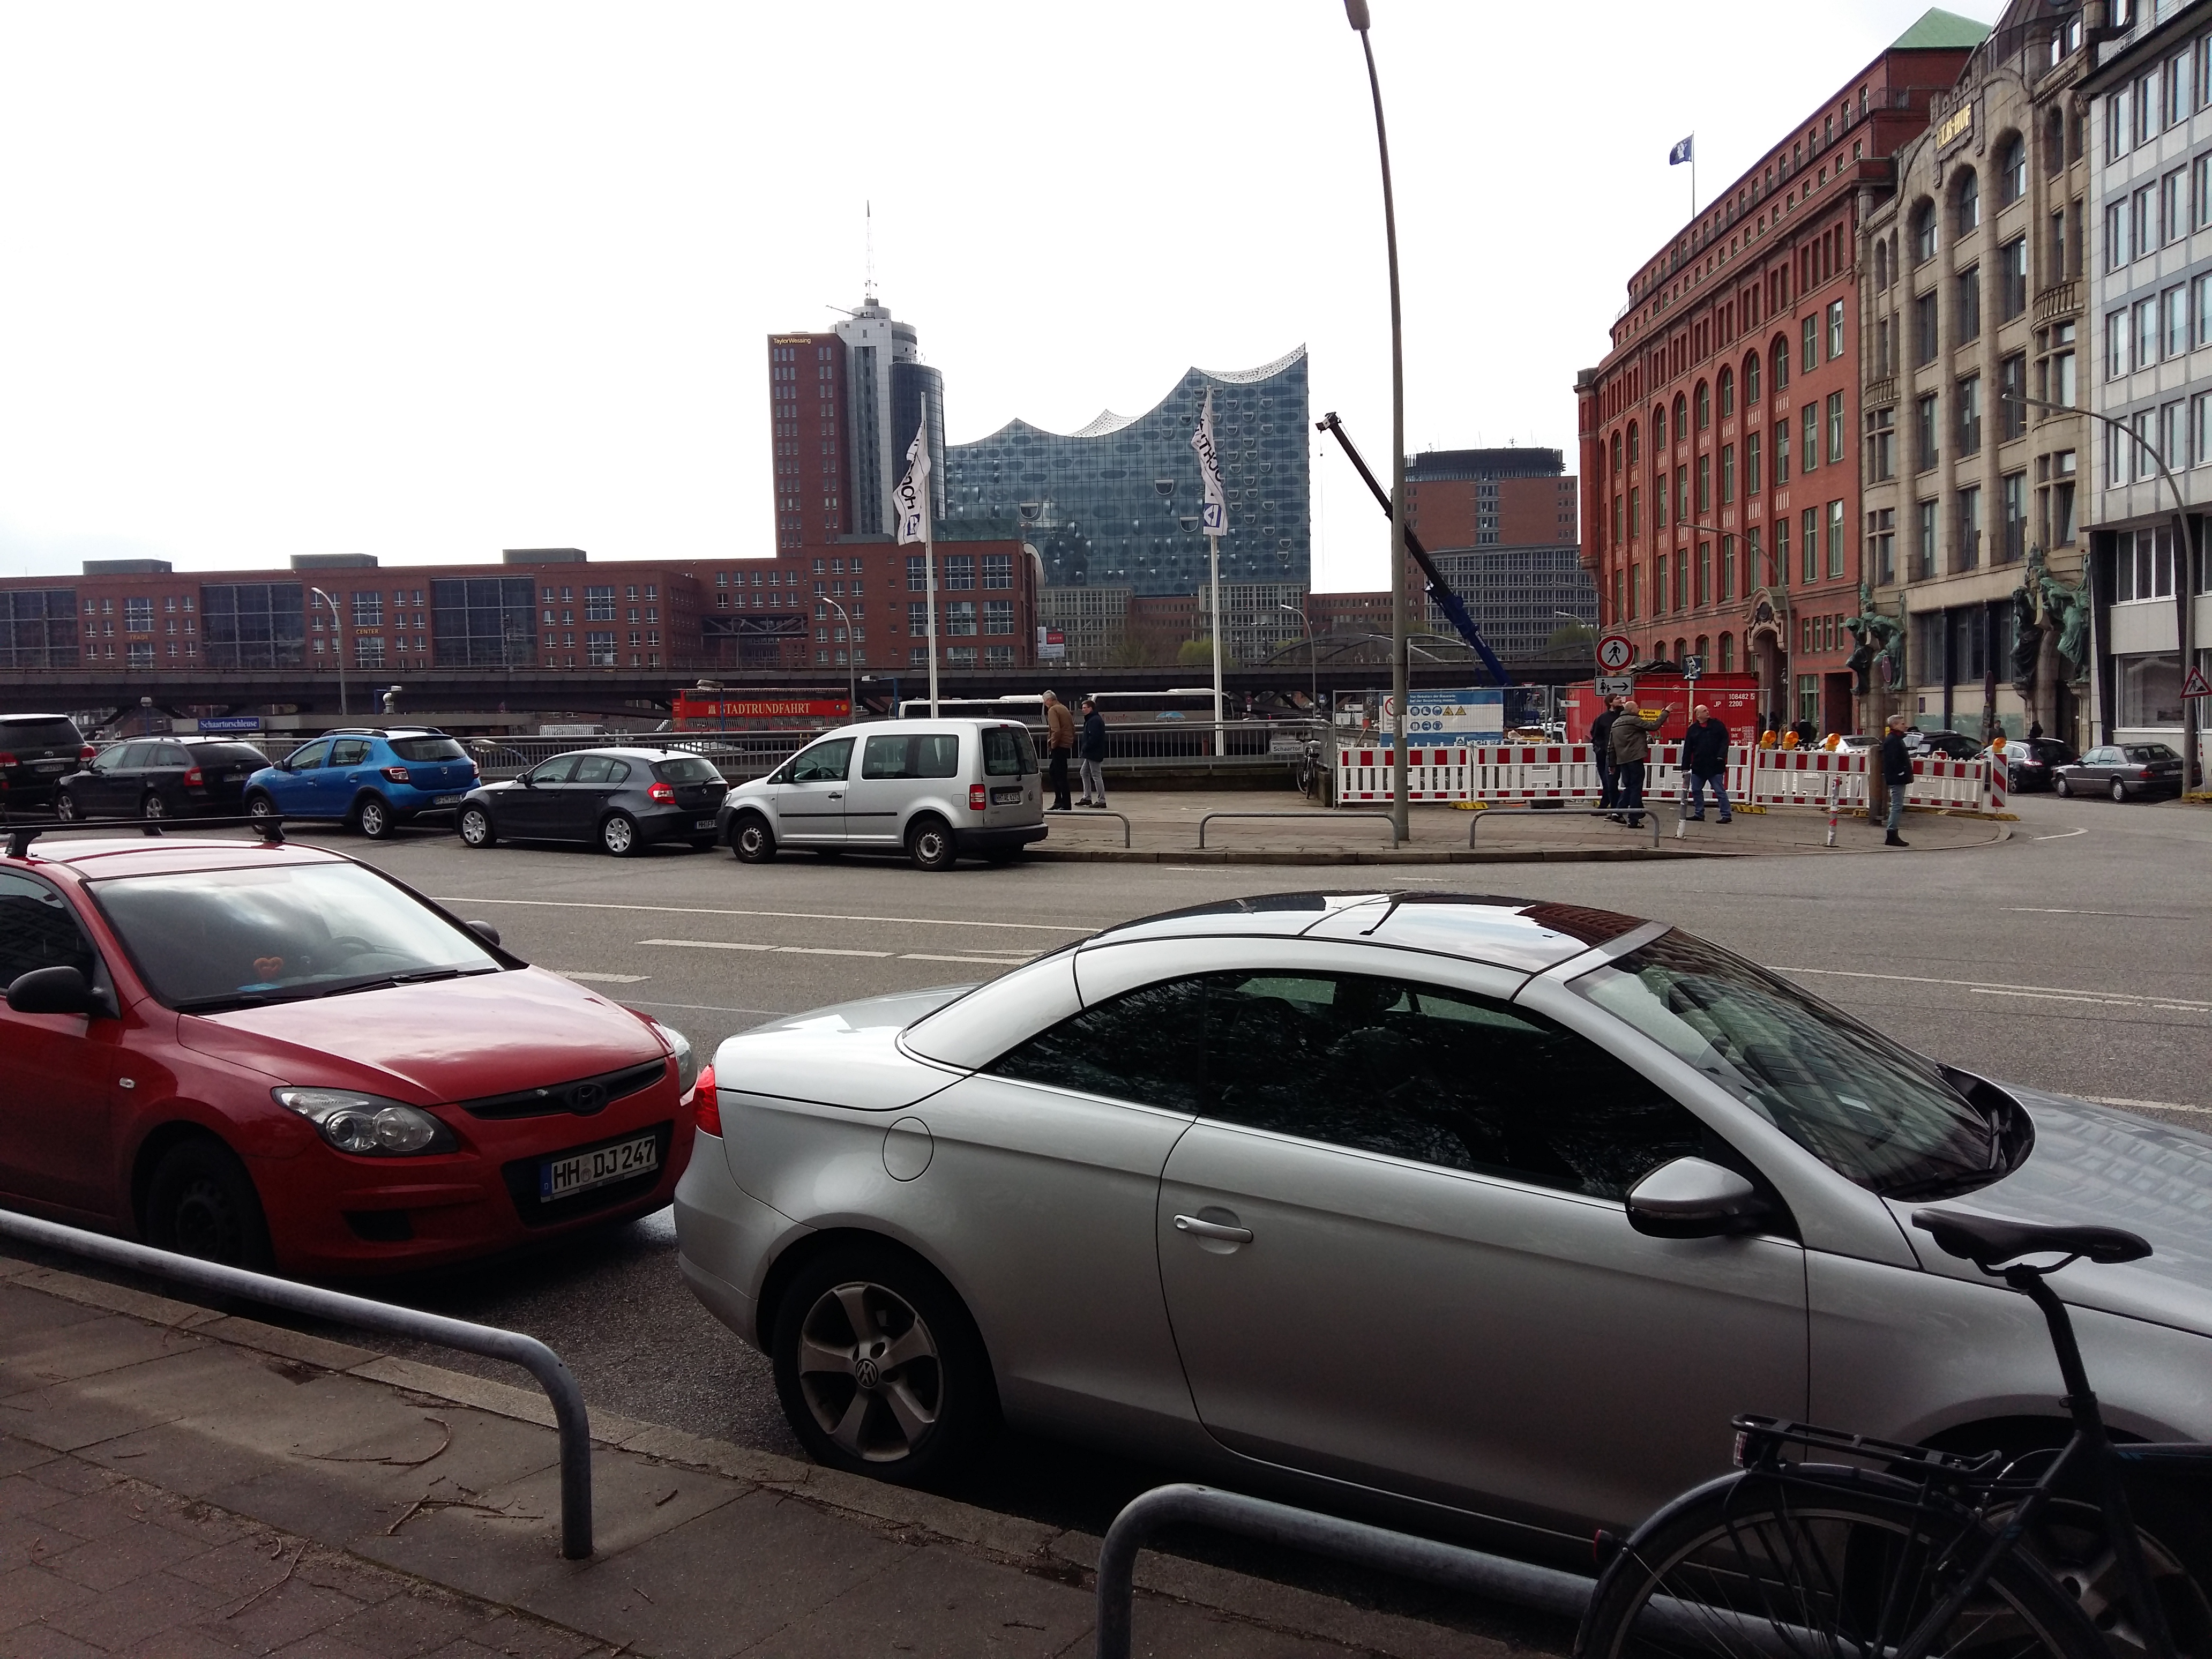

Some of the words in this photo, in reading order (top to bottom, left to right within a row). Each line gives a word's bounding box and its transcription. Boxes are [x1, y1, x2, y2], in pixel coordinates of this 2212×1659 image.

[200, 719, 257, 728] Schaartorschleuse
[554, 1159, 580, 1190] HH
[593, 1149, 617, 1178] DJ
[622, 1138, 655, 1170] 247
